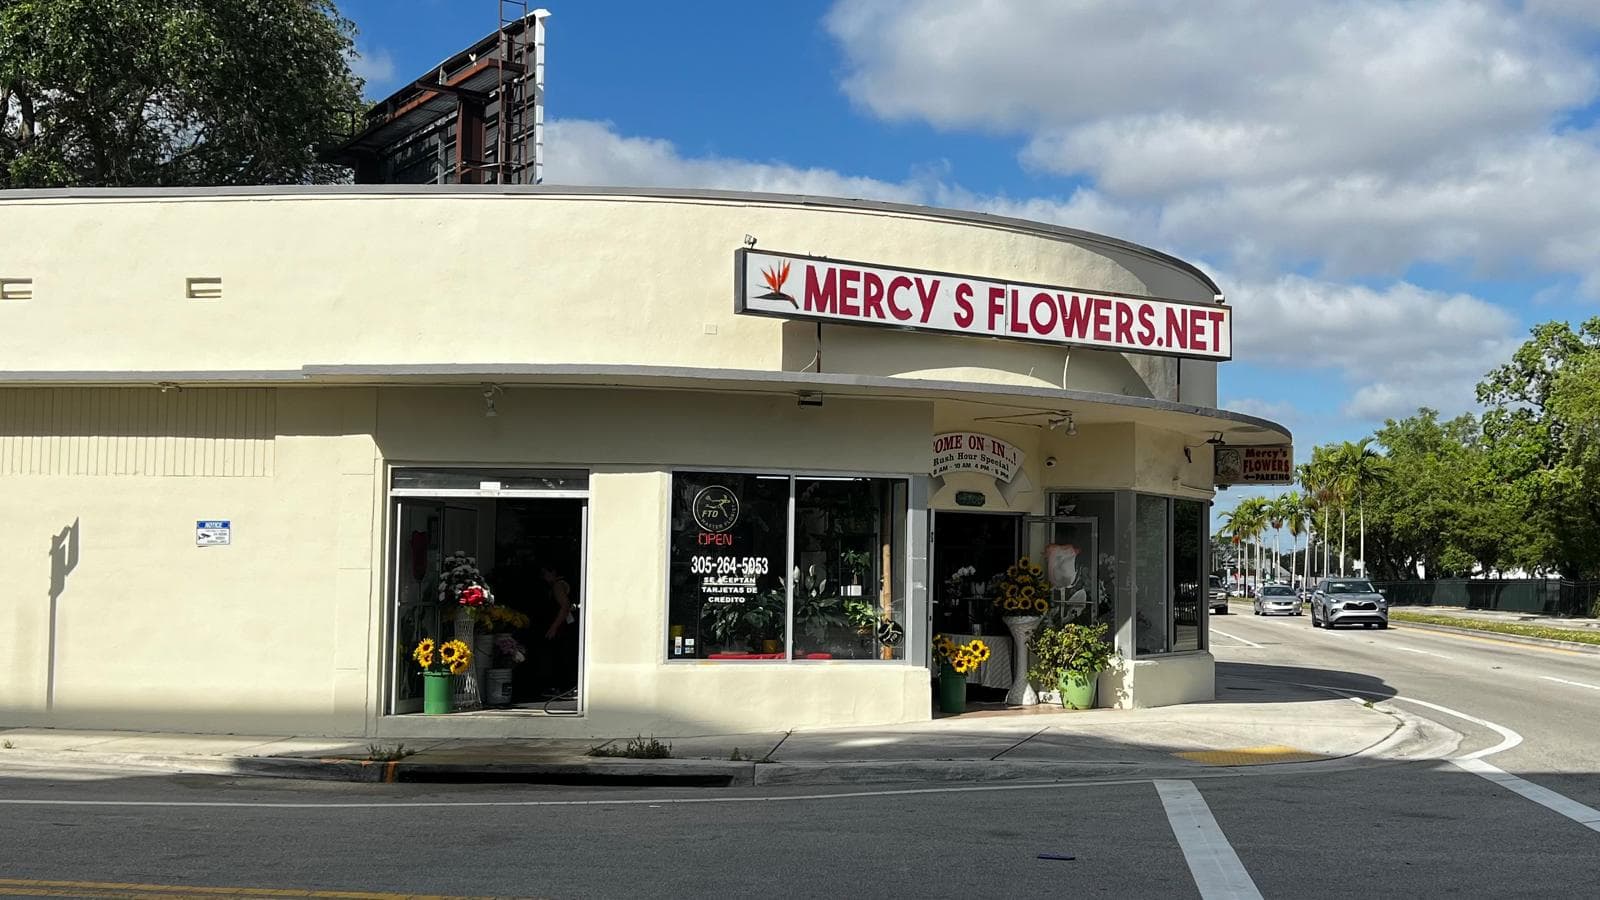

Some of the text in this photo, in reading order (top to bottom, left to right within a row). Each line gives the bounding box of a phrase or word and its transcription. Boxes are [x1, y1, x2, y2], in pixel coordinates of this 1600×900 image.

[988, 287, 1225, 352] FLOWERS.NET
[934, 435, 962, 453] OME
[969, 435, 985, 451] ON
[1245, 448, 1288, 458] Mercy's
[933, 452, 1009, 472] Rush Hour Special
[1243, 460, 1290, 473] FLOWERS
[702, 510, 719, 518] FTD
[698, 532, 732, 546] OPEN
[691, 555, 769, 575] 305-264-5053
[717, 576, 756, 584] ACEPTAN
